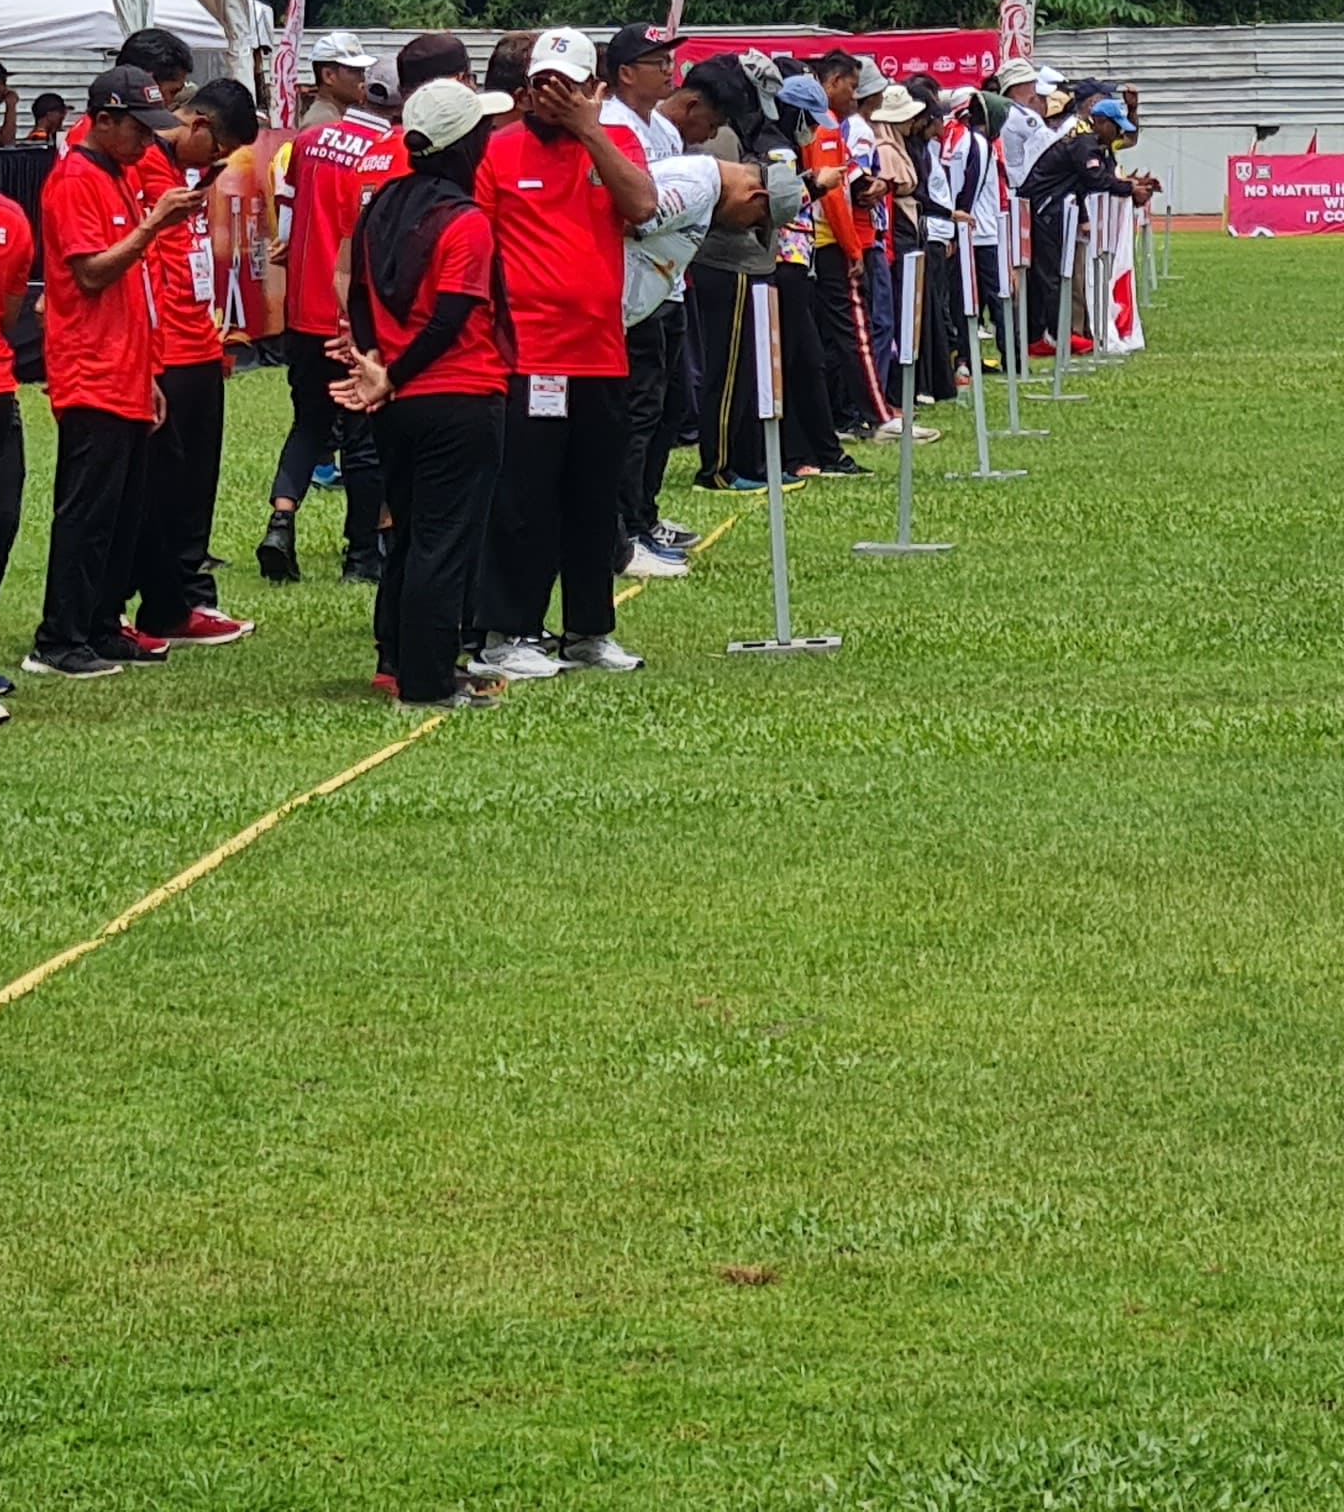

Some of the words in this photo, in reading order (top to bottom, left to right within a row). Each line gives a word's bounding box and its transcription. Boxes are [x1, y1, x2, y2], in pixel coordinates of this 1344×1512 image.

[1244, 185, 1267, 197] NO
[1272, 184, 1330, 196] MATTER
[1306, 210, 1319, 223] IT
